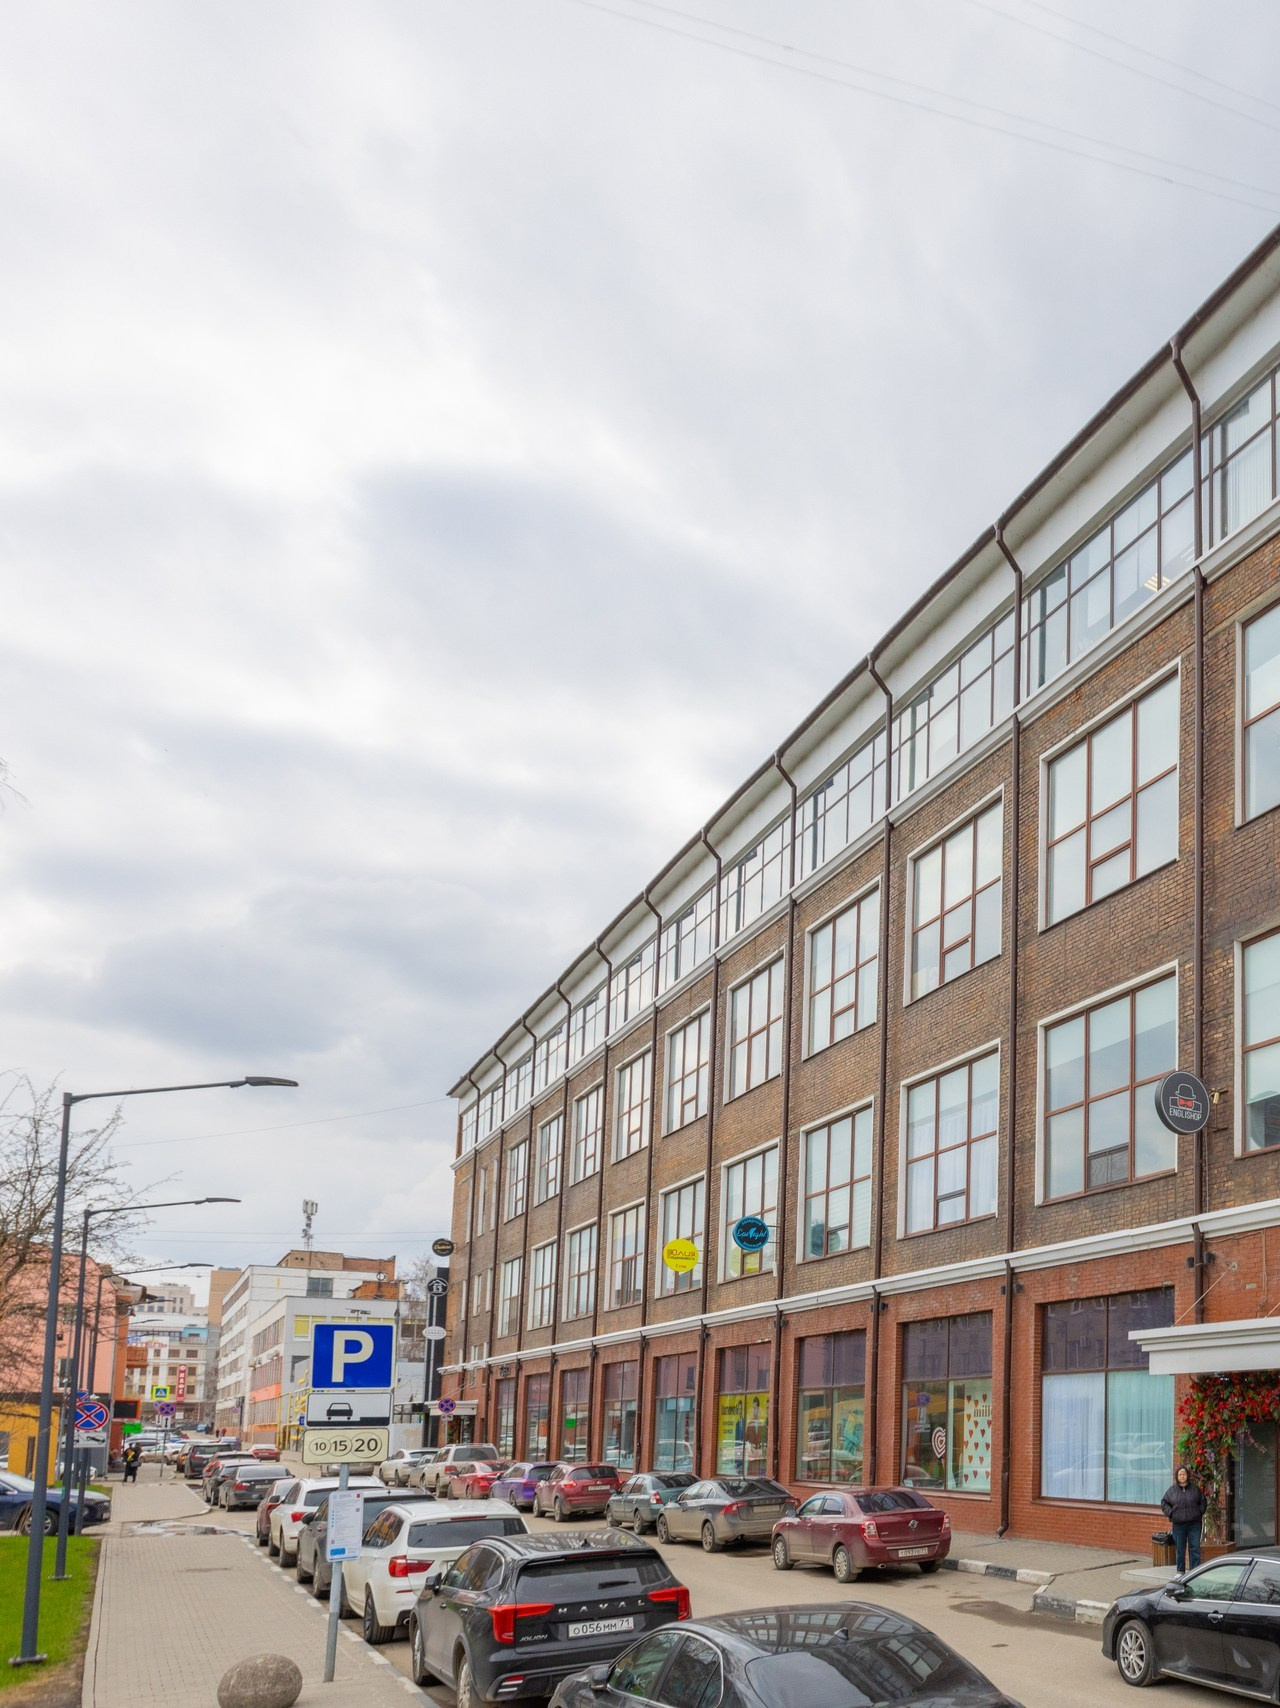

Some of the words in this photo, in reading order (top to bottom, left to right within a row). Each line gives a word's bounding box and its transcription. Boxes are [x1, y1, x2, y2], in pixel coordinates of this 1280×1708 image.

[1169, 1107, 1202, 1121] ENGLISHOP
[331, 1330, 374, 1383] P
[314, 1442, 327, 1451] 10
[332, 1440, 348, 1452] 15
[354, 1438, 378, 1452] 20
[558, 1600, 645, 1614] HAVAL
[519, 1634, 548, 1642] JOLION
